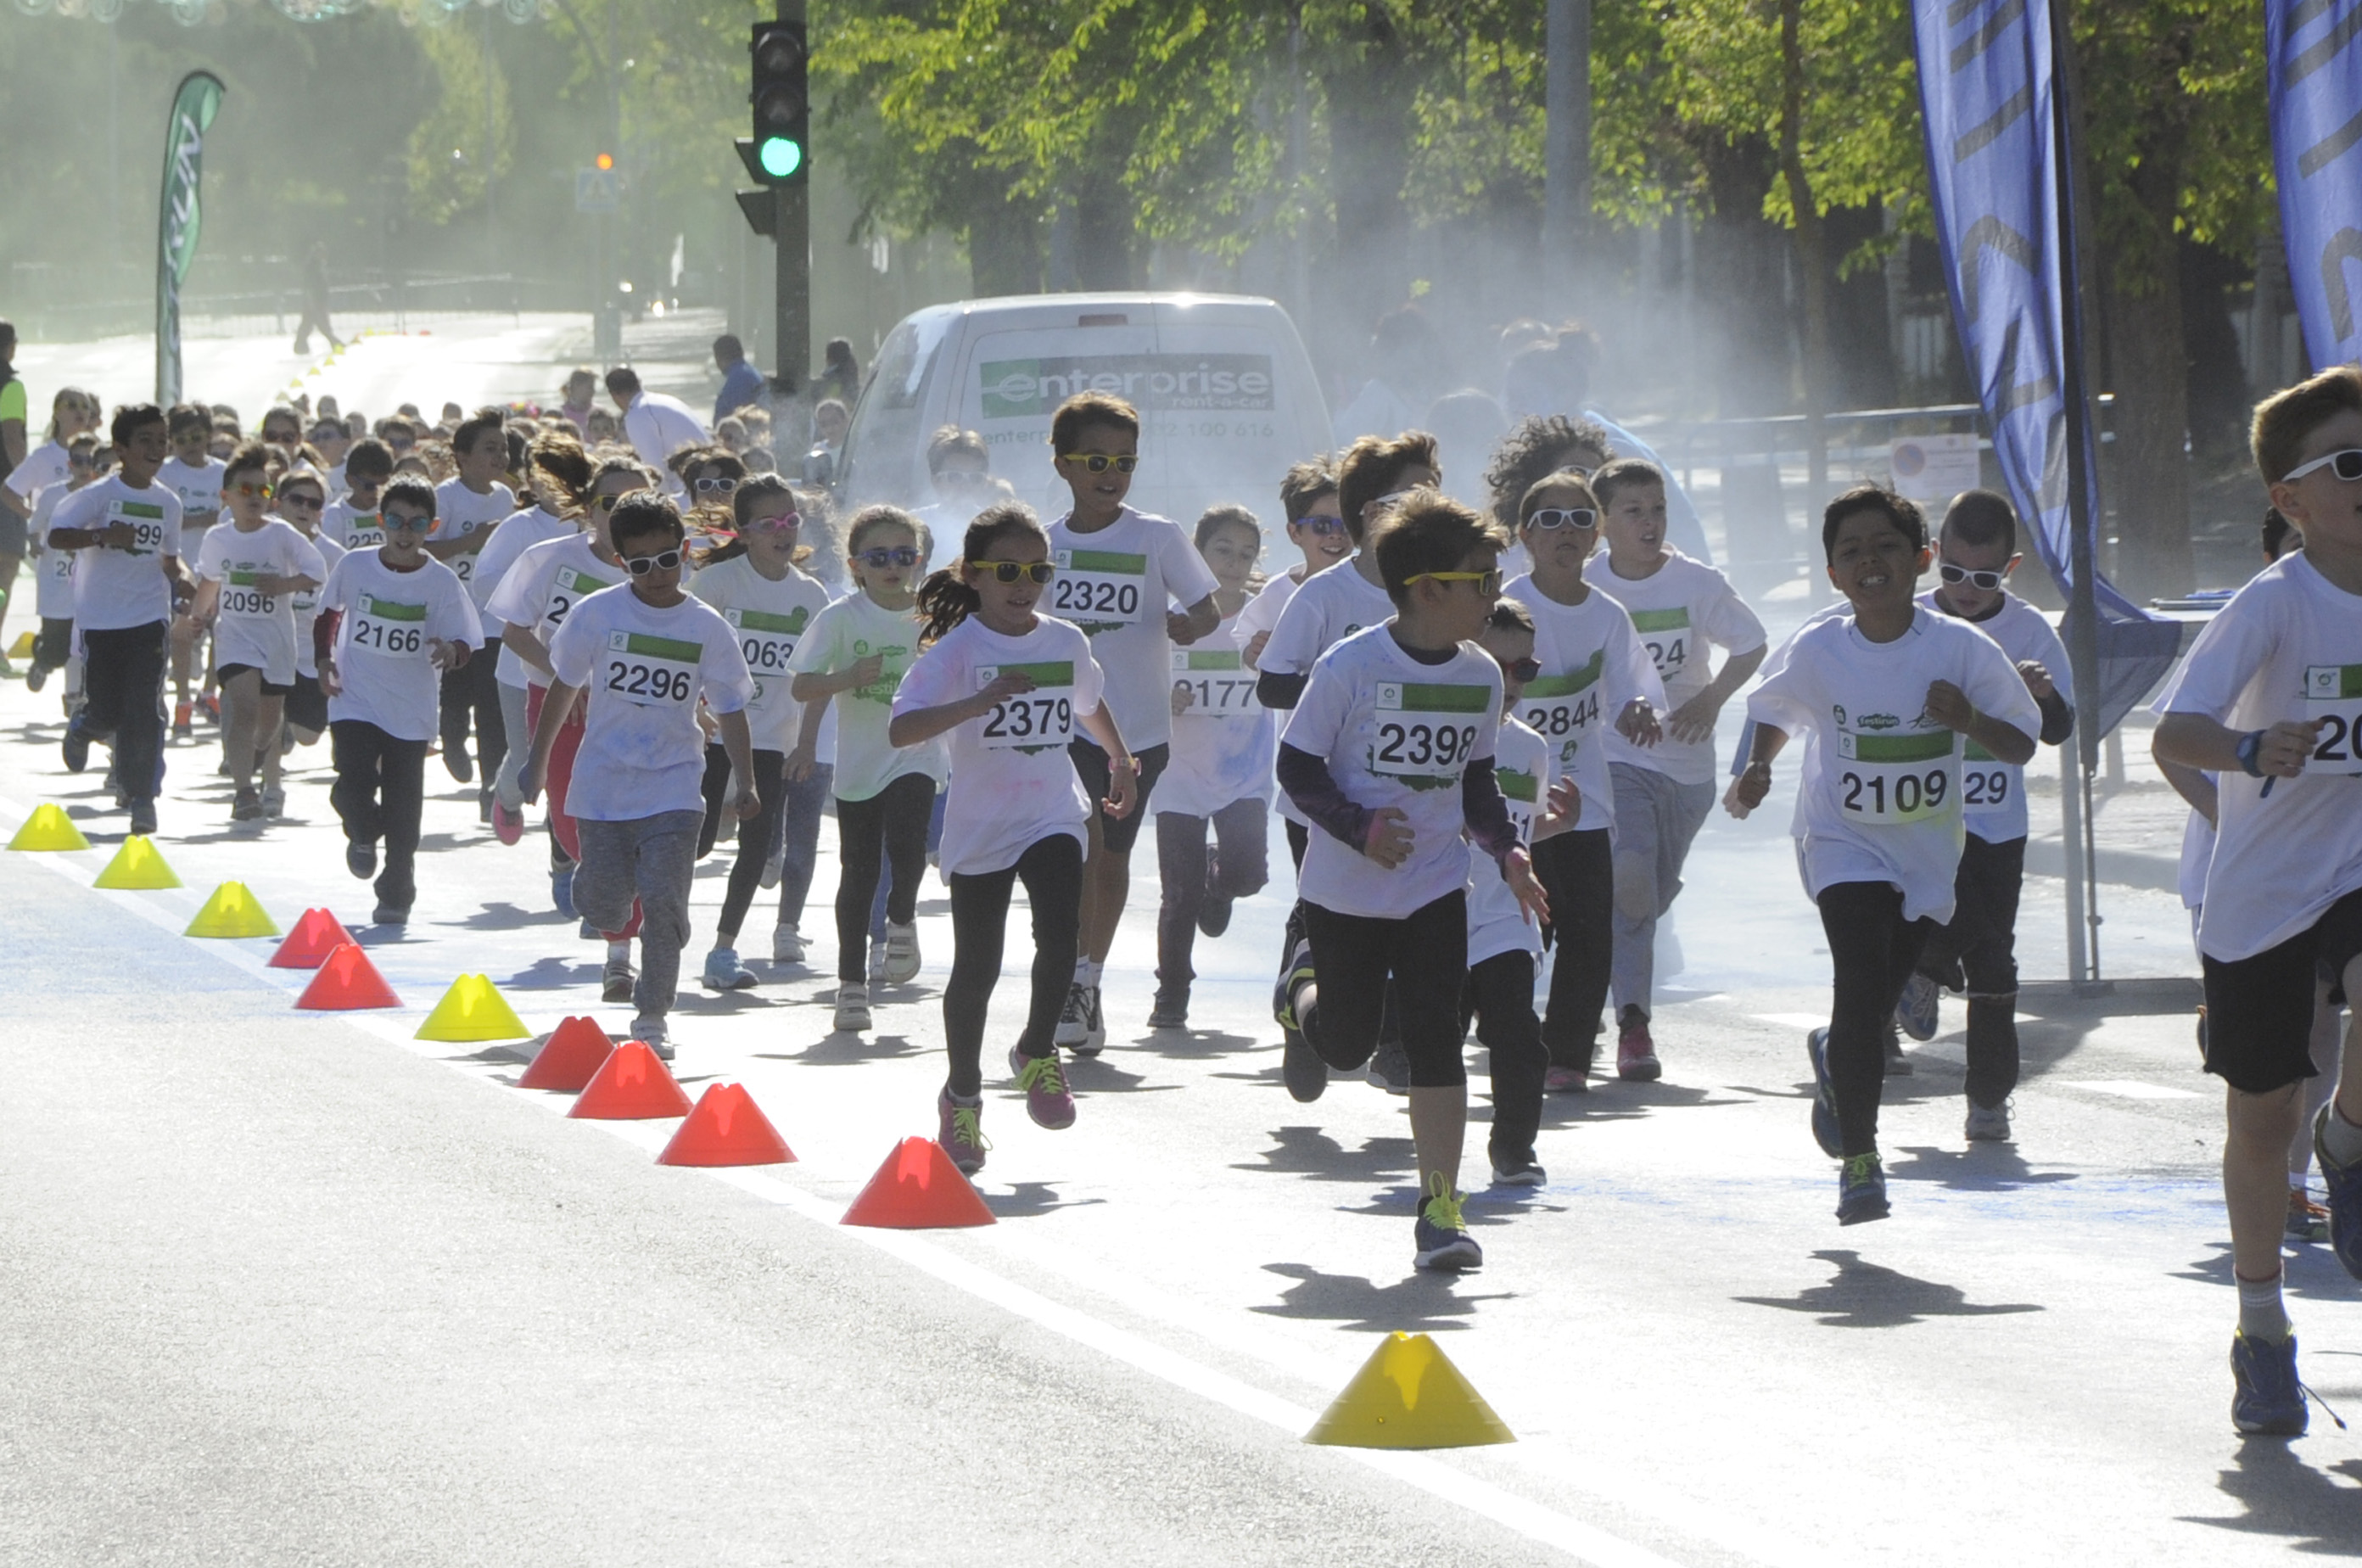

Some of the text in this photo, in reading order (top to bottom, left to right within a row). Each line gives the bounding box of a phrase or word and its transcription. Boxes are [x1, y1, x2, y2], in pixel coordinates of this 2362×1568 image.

[982, 362, 1269, 402] enterprise
[1173, 396, 1270, 408] rent-a-car
[1188, 422, 1227, 437] 100
[1234, 422, 1274, 437] 616
[223, 591, 275, 613] 2096
[1055, 579, 1139, 614] 2320
[354, 619, 421, 652] 2166
[742, 638, 794, 669] 063
[608, 661, 691, 702] 2296
[982, 697, 1071, 738] 2379
[1527, 692, 1599, 736] 2844
[1379, 723, 1476, 765] 2398
[1842, 770, 1947, 814] 2109
[1964, 770, 2007, 804] 29
